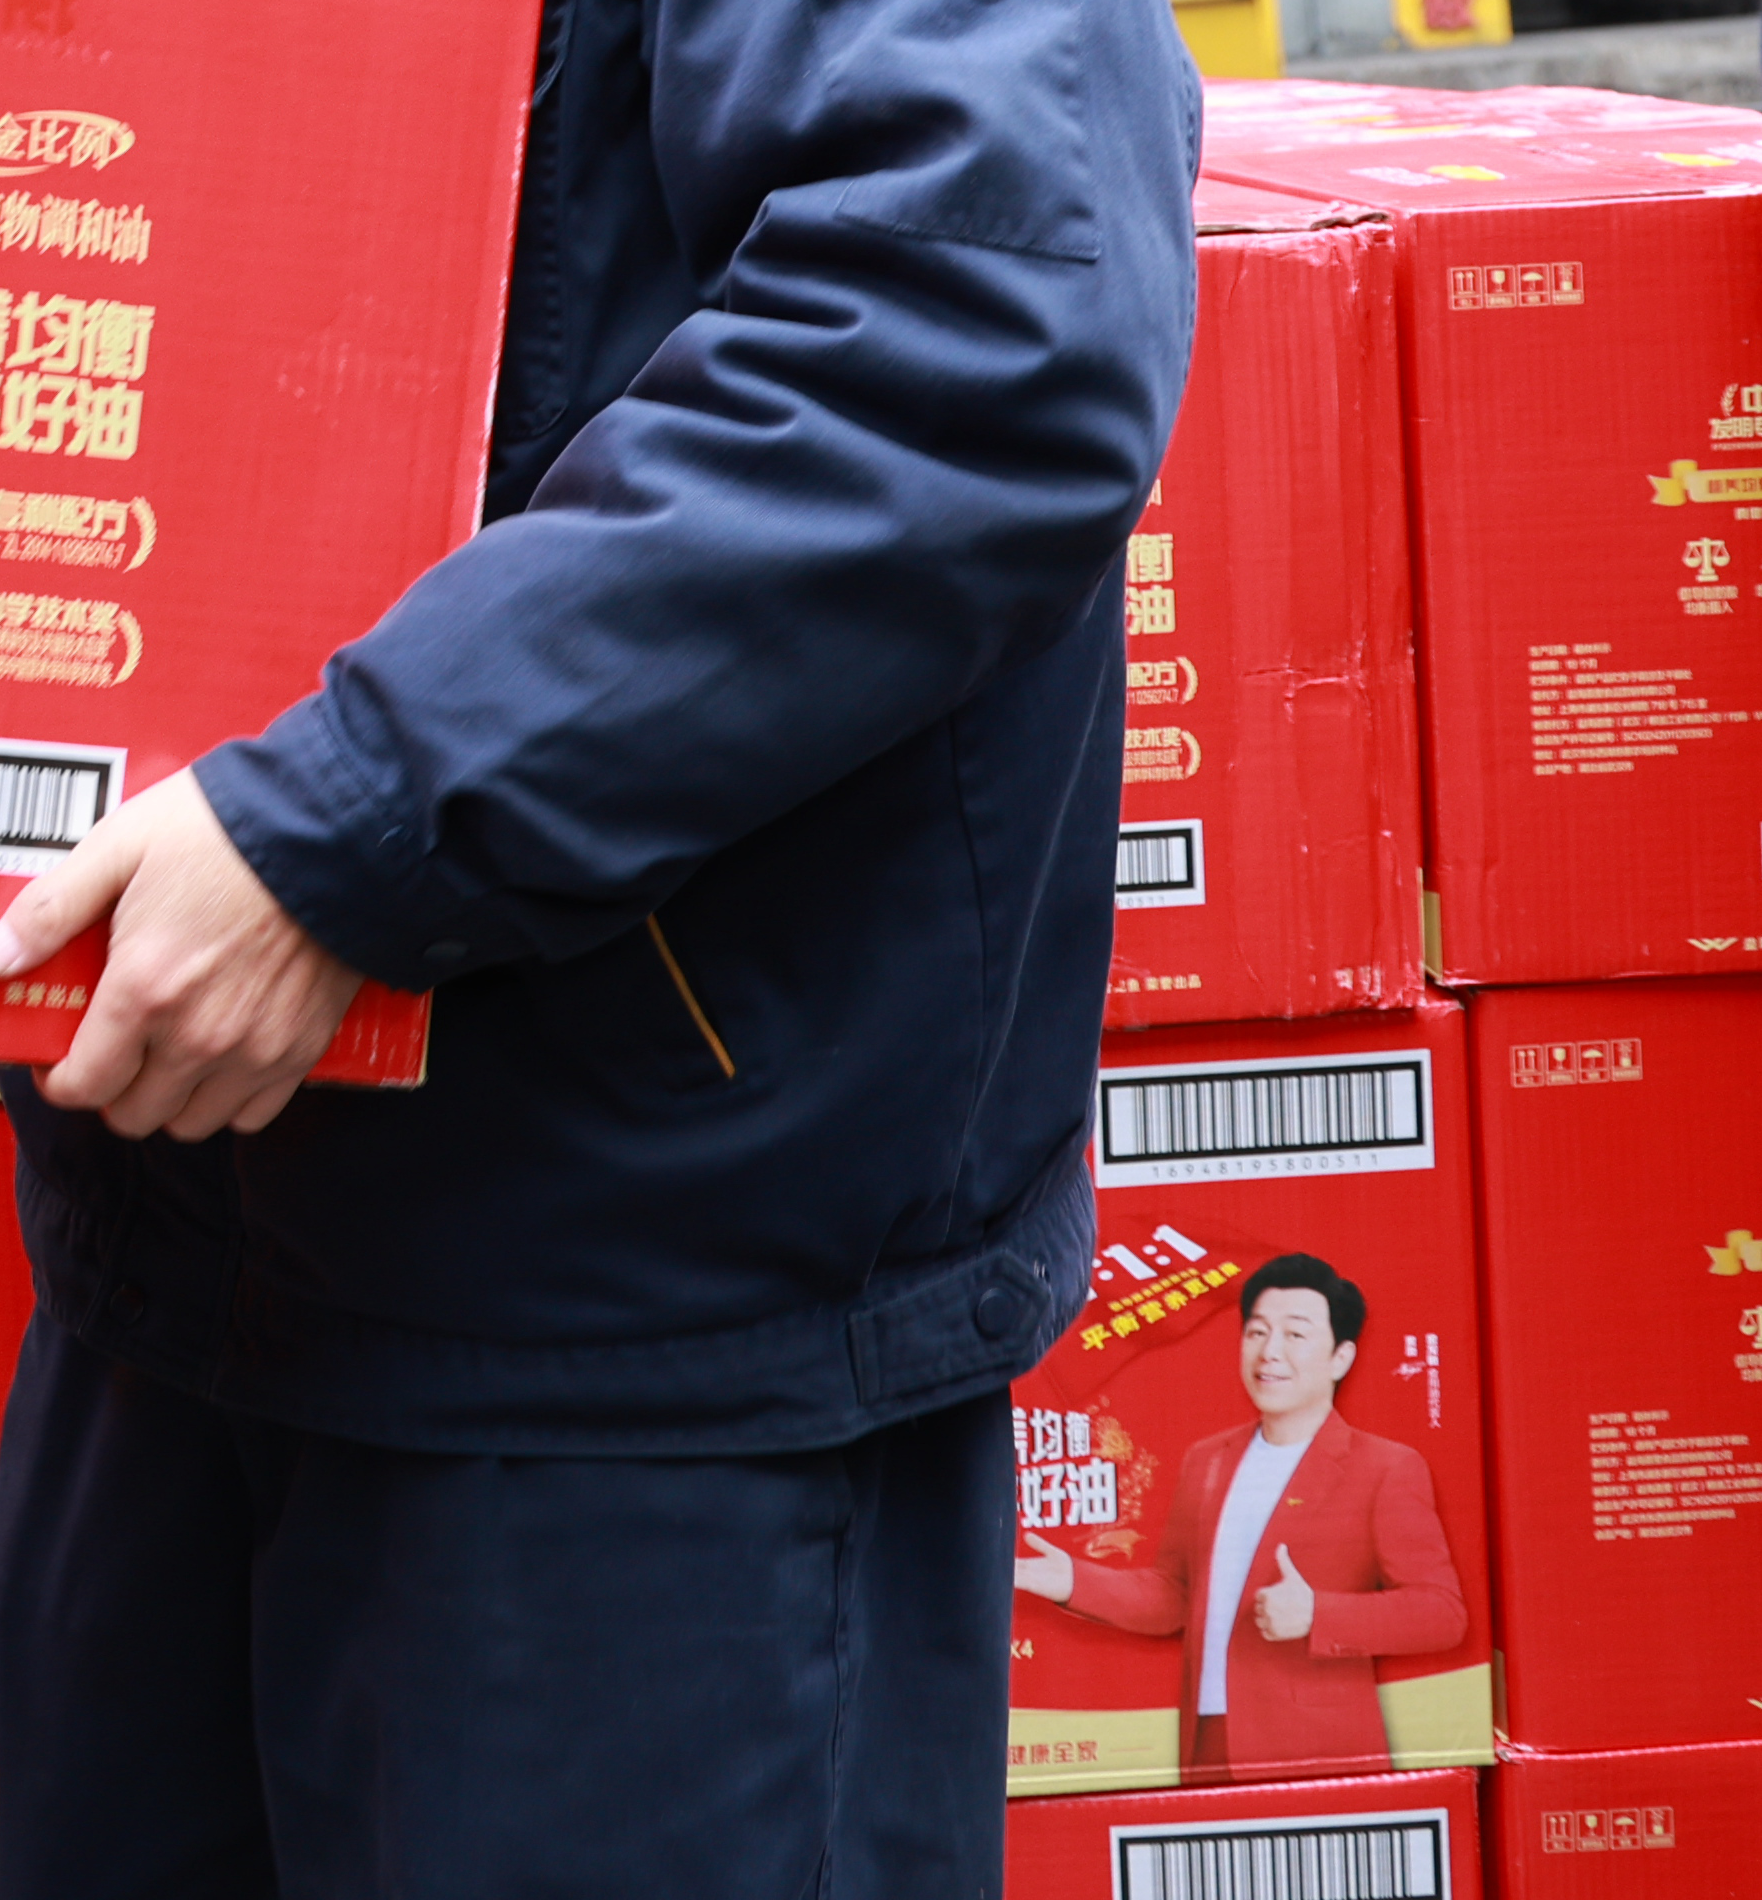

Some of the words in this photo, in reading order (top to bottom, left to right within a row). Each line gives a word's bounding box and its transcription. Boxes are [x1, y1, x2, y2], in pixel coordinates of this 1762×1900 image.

[1128, 661, 1177, 687] 配方
[1152, 1153, 1378, 1179] 16948195800511
[1087, 1224, 1208, 1302] :1:1
[1016, 1457, 1118, 1529] 好油
[1007, 1738, 1099, 1766] 健康全家
